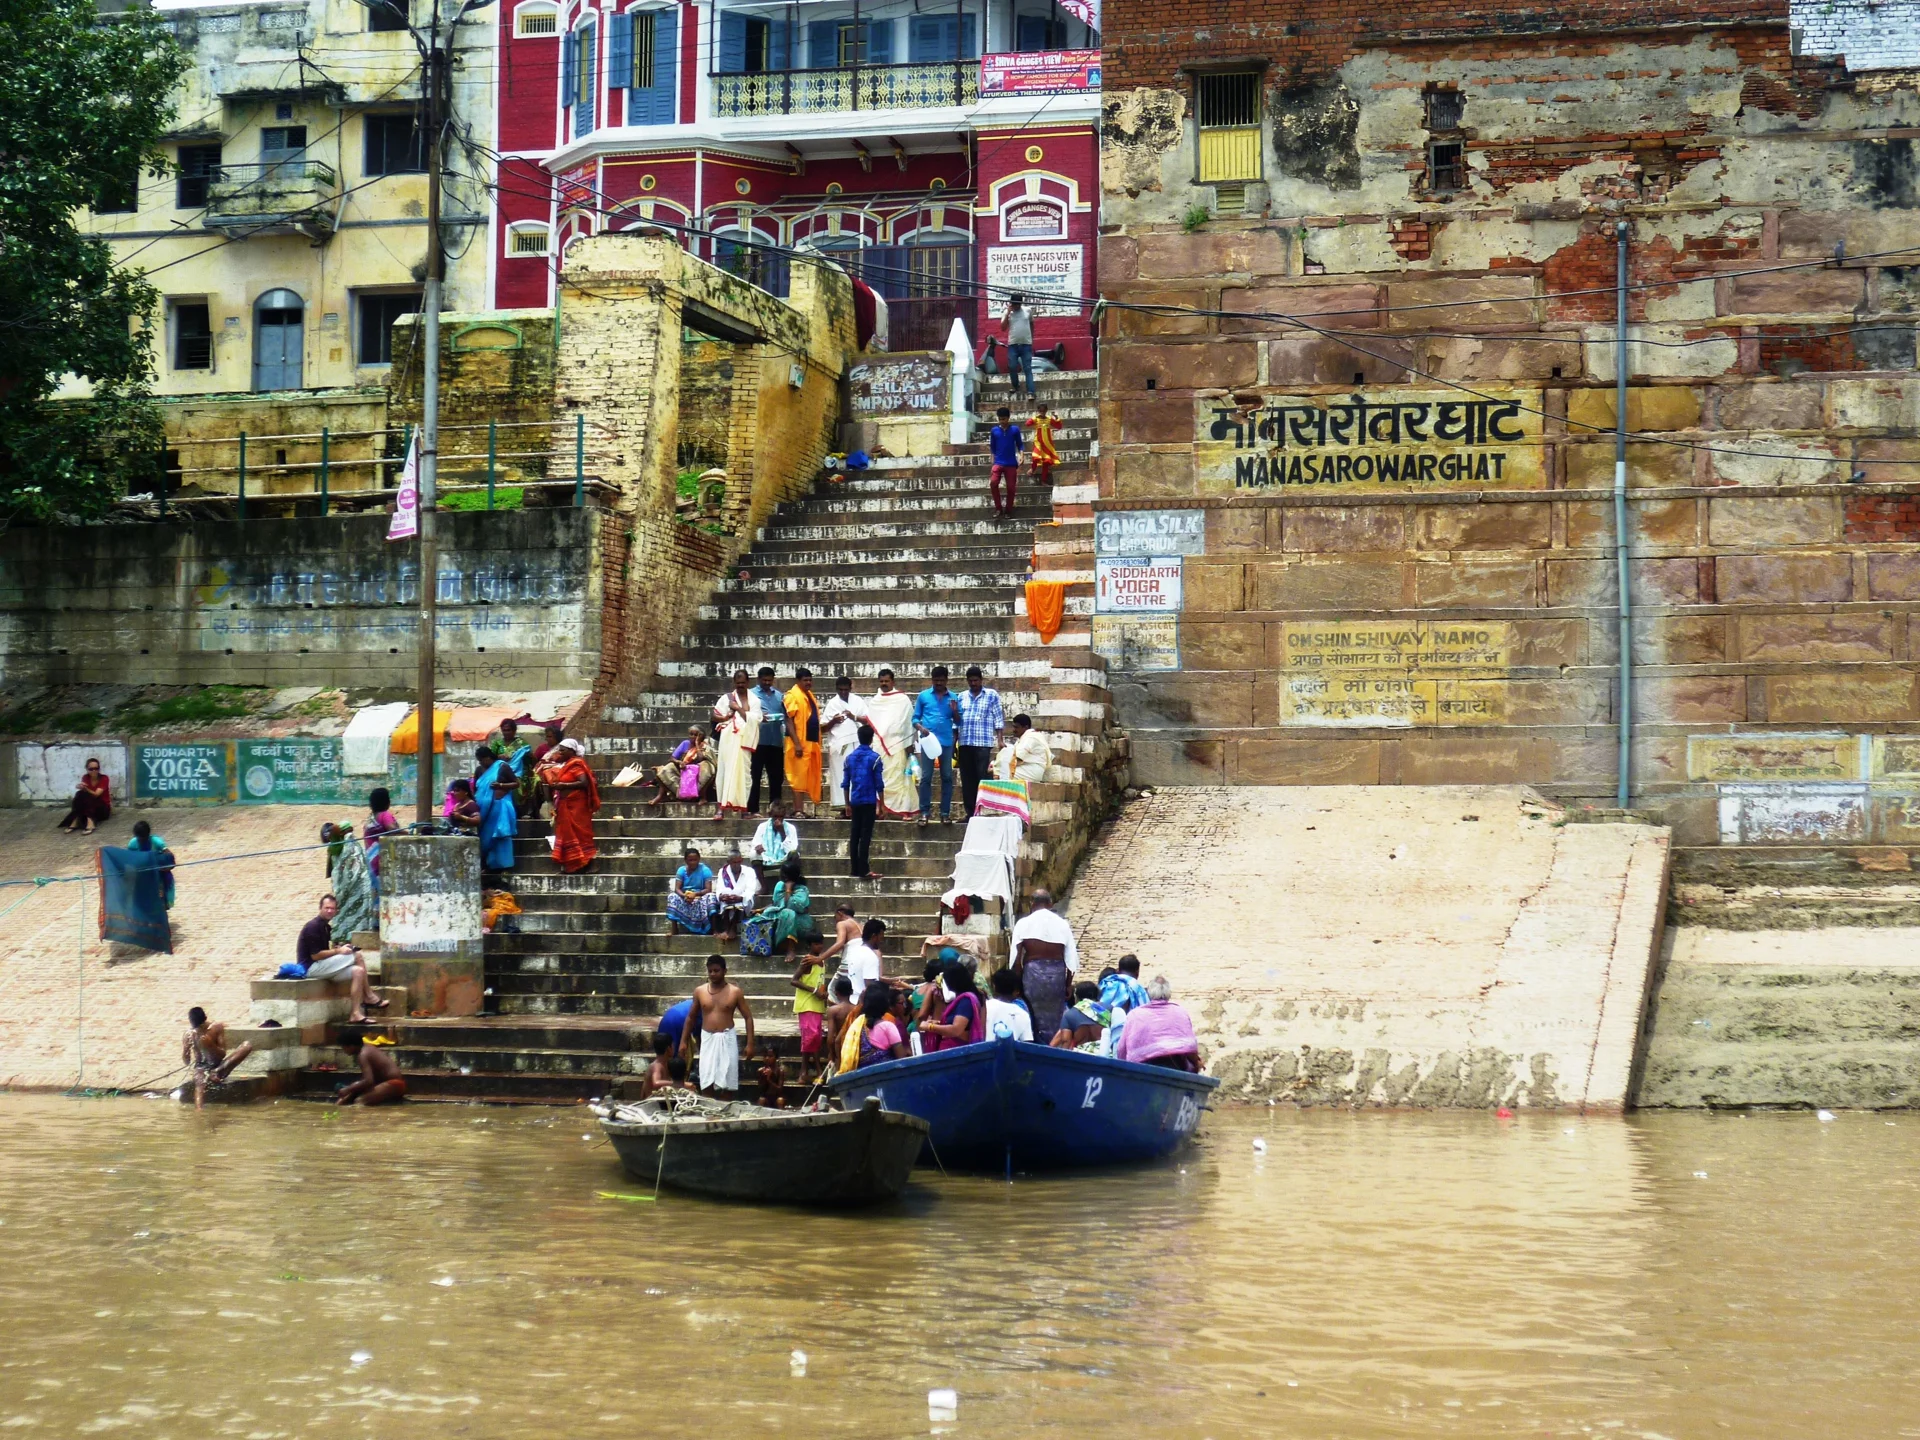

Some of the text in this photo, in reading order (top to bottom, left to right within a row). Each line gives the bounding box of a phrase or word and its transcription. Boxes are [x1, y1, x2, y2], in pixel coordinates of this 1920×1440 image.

[995, 52, 1061, 67] SHIVA GANGES VIEW
[1022, 204, 1048, 213] GANGES
[991, 251, 1079, 263] SHIVA GANGES VIEW
[1003, 264, 1034, 274] GUEST
[1037, 263, 1071, 273] HOUSE
[1010, 274, 1067, 284] INTERNET
[1434, 399, 1525, 445] घाट
[1099, 515, 1200, 535] GANGA SILK
[1120, 537, 1178, 551] EMPORIUM
[1111, 567, 1179, 578] SIDDHARTH
[1115, 580, 1160, 594] YOGA
[1115, 595, 1166, 605] CENTRE
[1288, 633, 1312, 648] OM
[1355, 630, 1427, 647] SHIVAY
[1434, 630, 1490, 645] NAMO
[143, 748, 217, 758] SIDDHARTH
[142, 758, 220, 778] YOGA
[148, 778, 208, 791] CENTRE
[1081, 1076, 1103, 1109] 12
